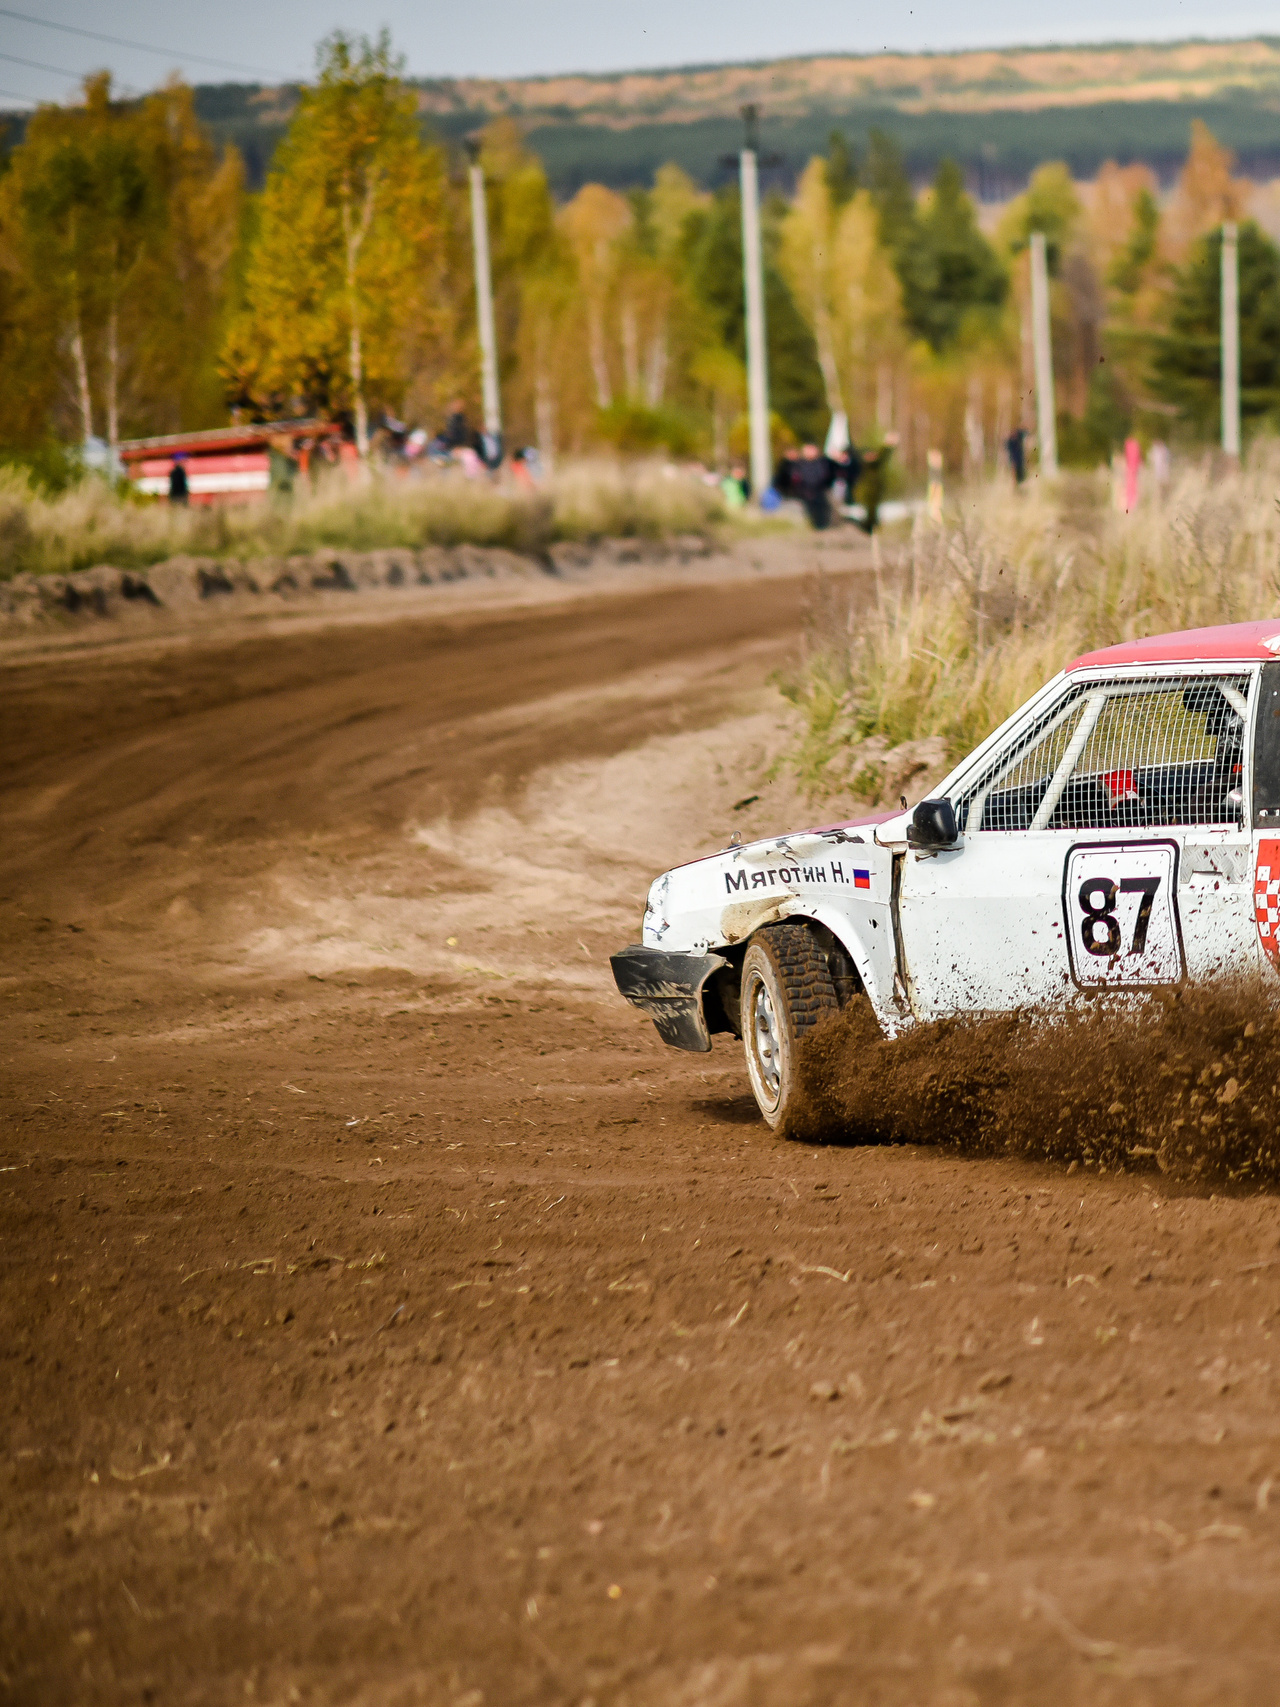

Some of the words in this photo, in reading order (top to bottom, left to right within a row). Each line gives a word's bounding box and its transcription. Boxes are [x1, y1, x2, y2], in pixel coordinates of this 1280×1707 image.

[724, 866, 827, 894] Мяготин
[830, 861, 850, 884] Н.
[1078, 876, 1161, 957] 87
